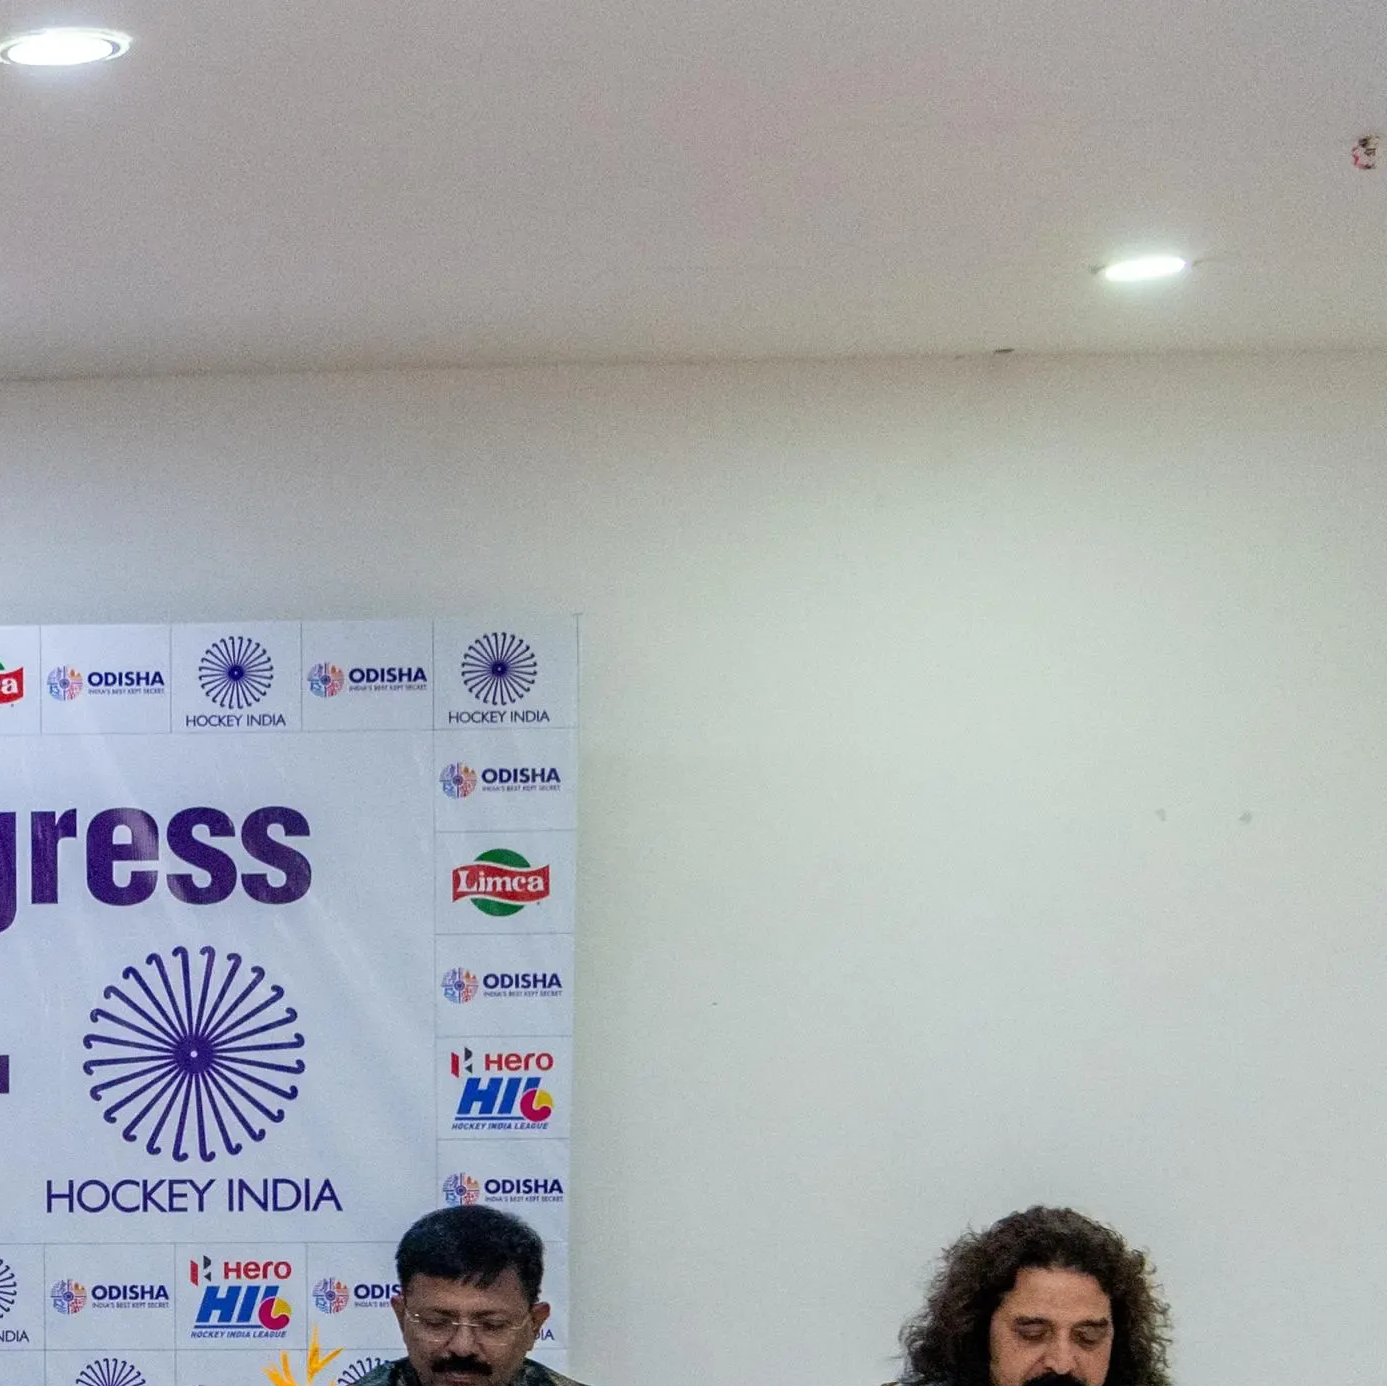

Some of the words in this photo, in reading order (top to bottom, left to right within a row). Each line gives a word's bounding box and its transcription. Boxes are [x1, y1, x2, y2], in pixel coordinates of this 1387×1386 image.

[88, 672, 165, 687] ODISHA
[349, 668, 428, 683] ODISHA
[186, 715, 242, 727] HOCKEY
[247, 714, 286, 726] INDIA
[449, 711, 506, 723] HOCKEY
[511, 710, 549, 722] INDIA
[482, 768, 561, 784] ODISHA
[457, 868, 545, 893] Limca
[483, 973, 562, 989] ODISHA
[485, 1053, 553, 1071] Hero
[485, 1179, 564, 1194] ODISHA
[47, 1179, 215, 1213] HOCKEY
[228, 1178, 342, 1211] INDIA
[224, 1261, 291, 1279] Hero
[92, 1285, 170, 1300] ODISHA
[354, 1284, 399, 1300] ODIS
[253, 1330, 286, 1338] LEAGUE
